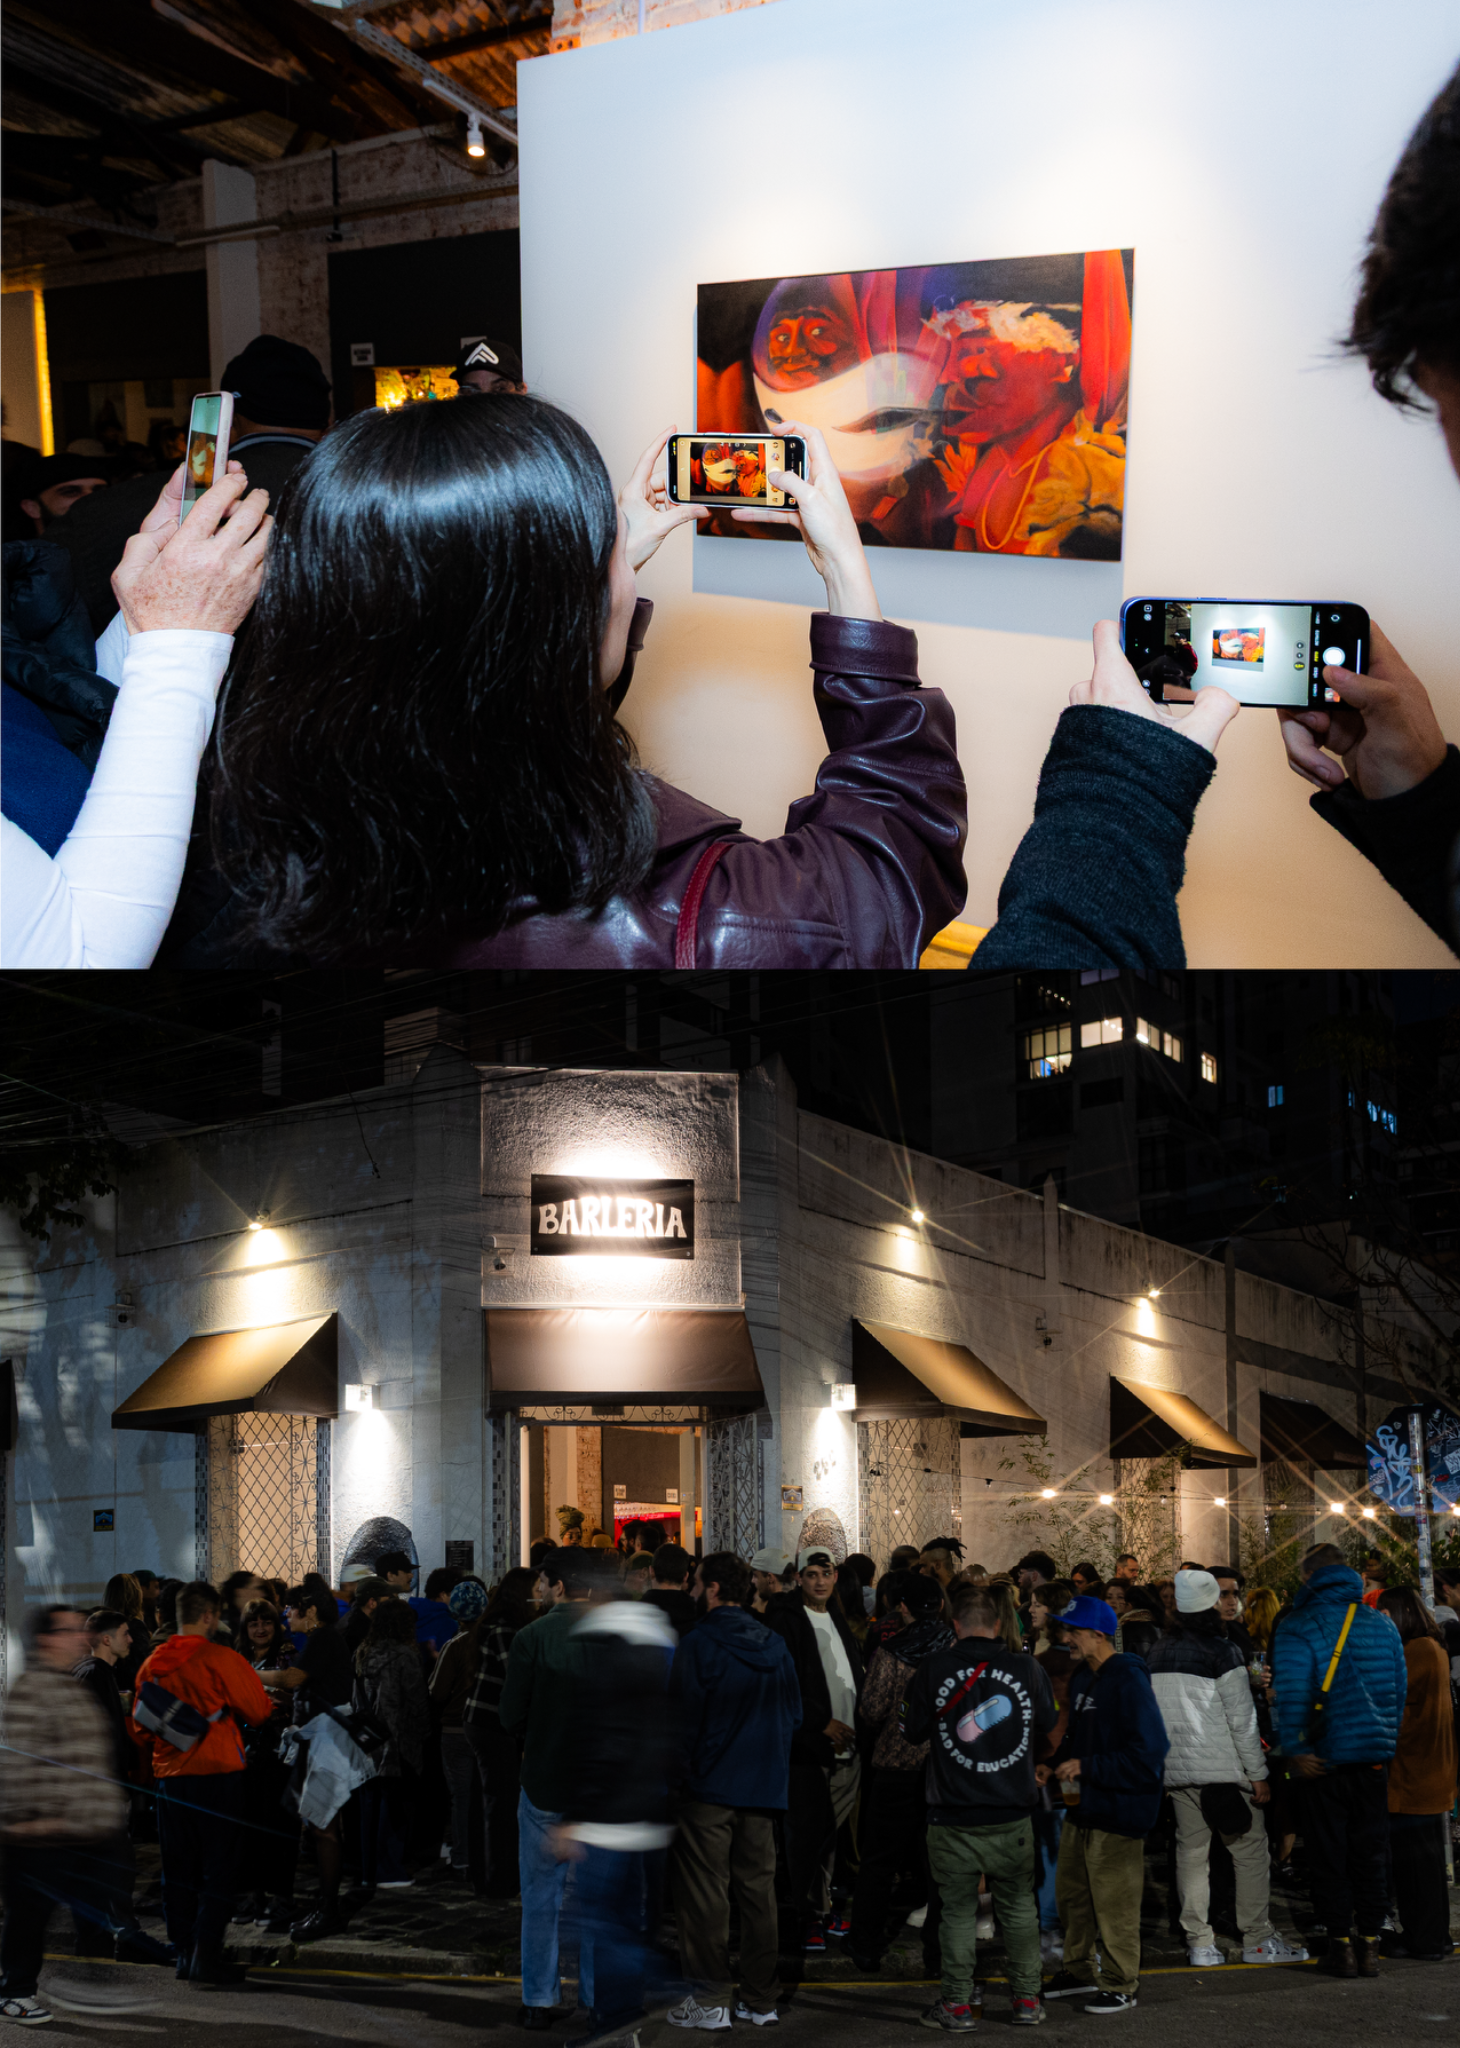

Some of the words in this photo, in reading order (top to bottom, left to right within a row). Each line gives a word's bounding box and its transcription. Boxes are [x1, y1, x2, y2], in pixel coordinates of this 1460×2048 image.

[538, 1195, 688, 1239] BARLERIA
[935, 1677, 956, 1713] OOD
[991, 1668, 1032, 1720] HEALTH
[938, 1722, 954, 1749] BAD
[950, 1748, 974, 1770] FOR
[976, 1726, 1031, 1773] EDUCATION
